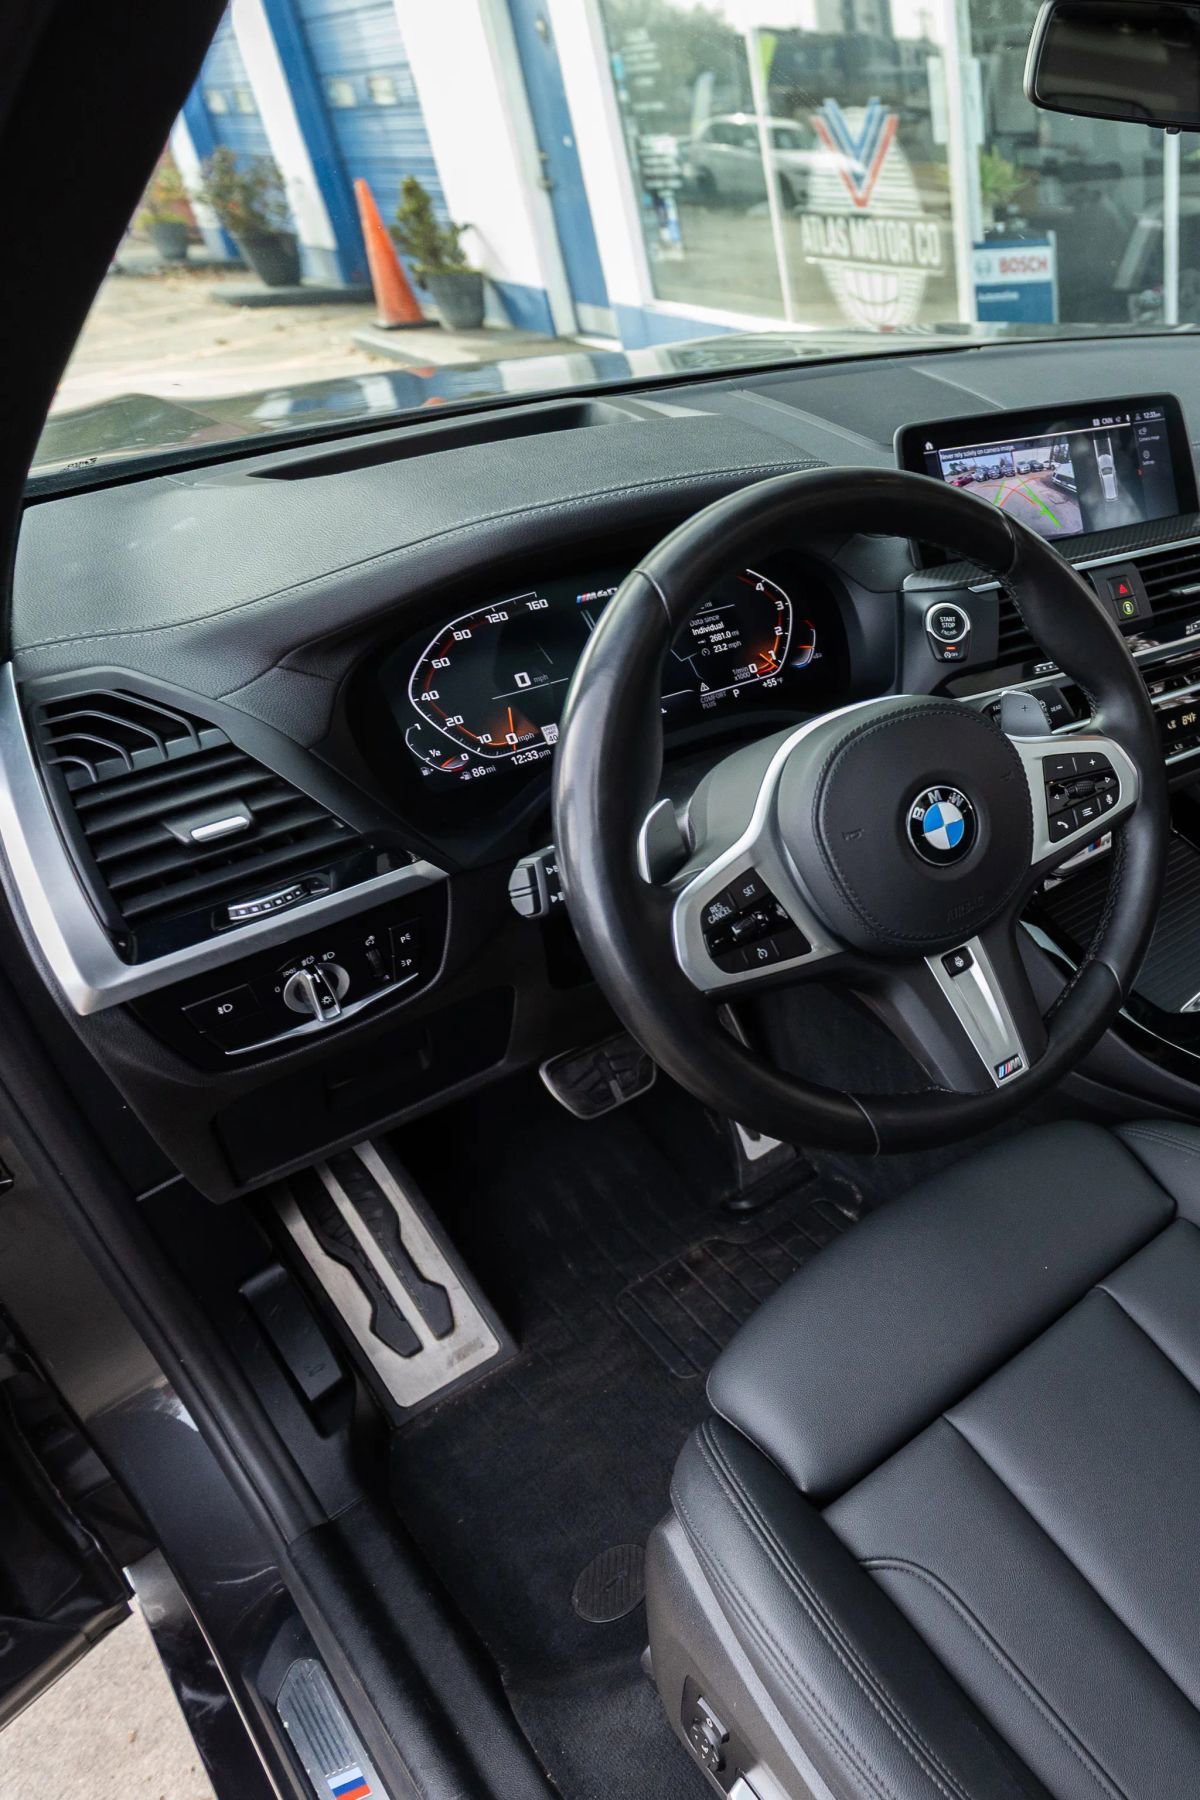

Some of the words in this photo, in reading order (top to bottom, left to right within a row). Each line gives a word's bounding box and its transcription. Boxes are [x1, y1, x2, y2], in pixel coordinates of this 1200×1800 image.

[801, 214, 850, 257] ATLAS
[849, 217, 914, 265] MOTOR
[913, 221, 941, 267] CO
[998, 255, 1048, 275] BOSCH
[756, 582, 764, 592] 4
[525, 599, 549, 611] 160
[774, 600, 784, 611] 3
[485, 611, 509, 623] 120
[692, 621, 724, 636] Individual
[774, 626, 783, 636] 2
[453, 629, 472, 641] 80
[713, 643, 729, 653] 23.2
[768, 650, 776, 660] 1
[431, 657, 451, 669] 60
[748, 663, 758, 674] 0
[514, 672, 532, 688] 0
[533, 674, 549, 683] mph
[762, 677, 777, 688] +55
[421, 690, 440, 701] 40
[700, 690, 727, 704] COMFORT
[732, 688, 740, 698] P
[445, 715, 464, 727] 20
[479, 733, 492, 744] 10
[506, 732, 518, 745] 0
[517, 732, 535, 742] mph
[461, 753, 469, 761] 0
[511, 751, 540, 765] 12:33
[539, 749, 551, 760] pm
[472, 766, 487, 778] 86
[486, 765, 497, 774] mi
[912, 789, 964, 821] BMW
[742, 884, 756, 897] SET
[707, 906, 732, 924] CANCEL
